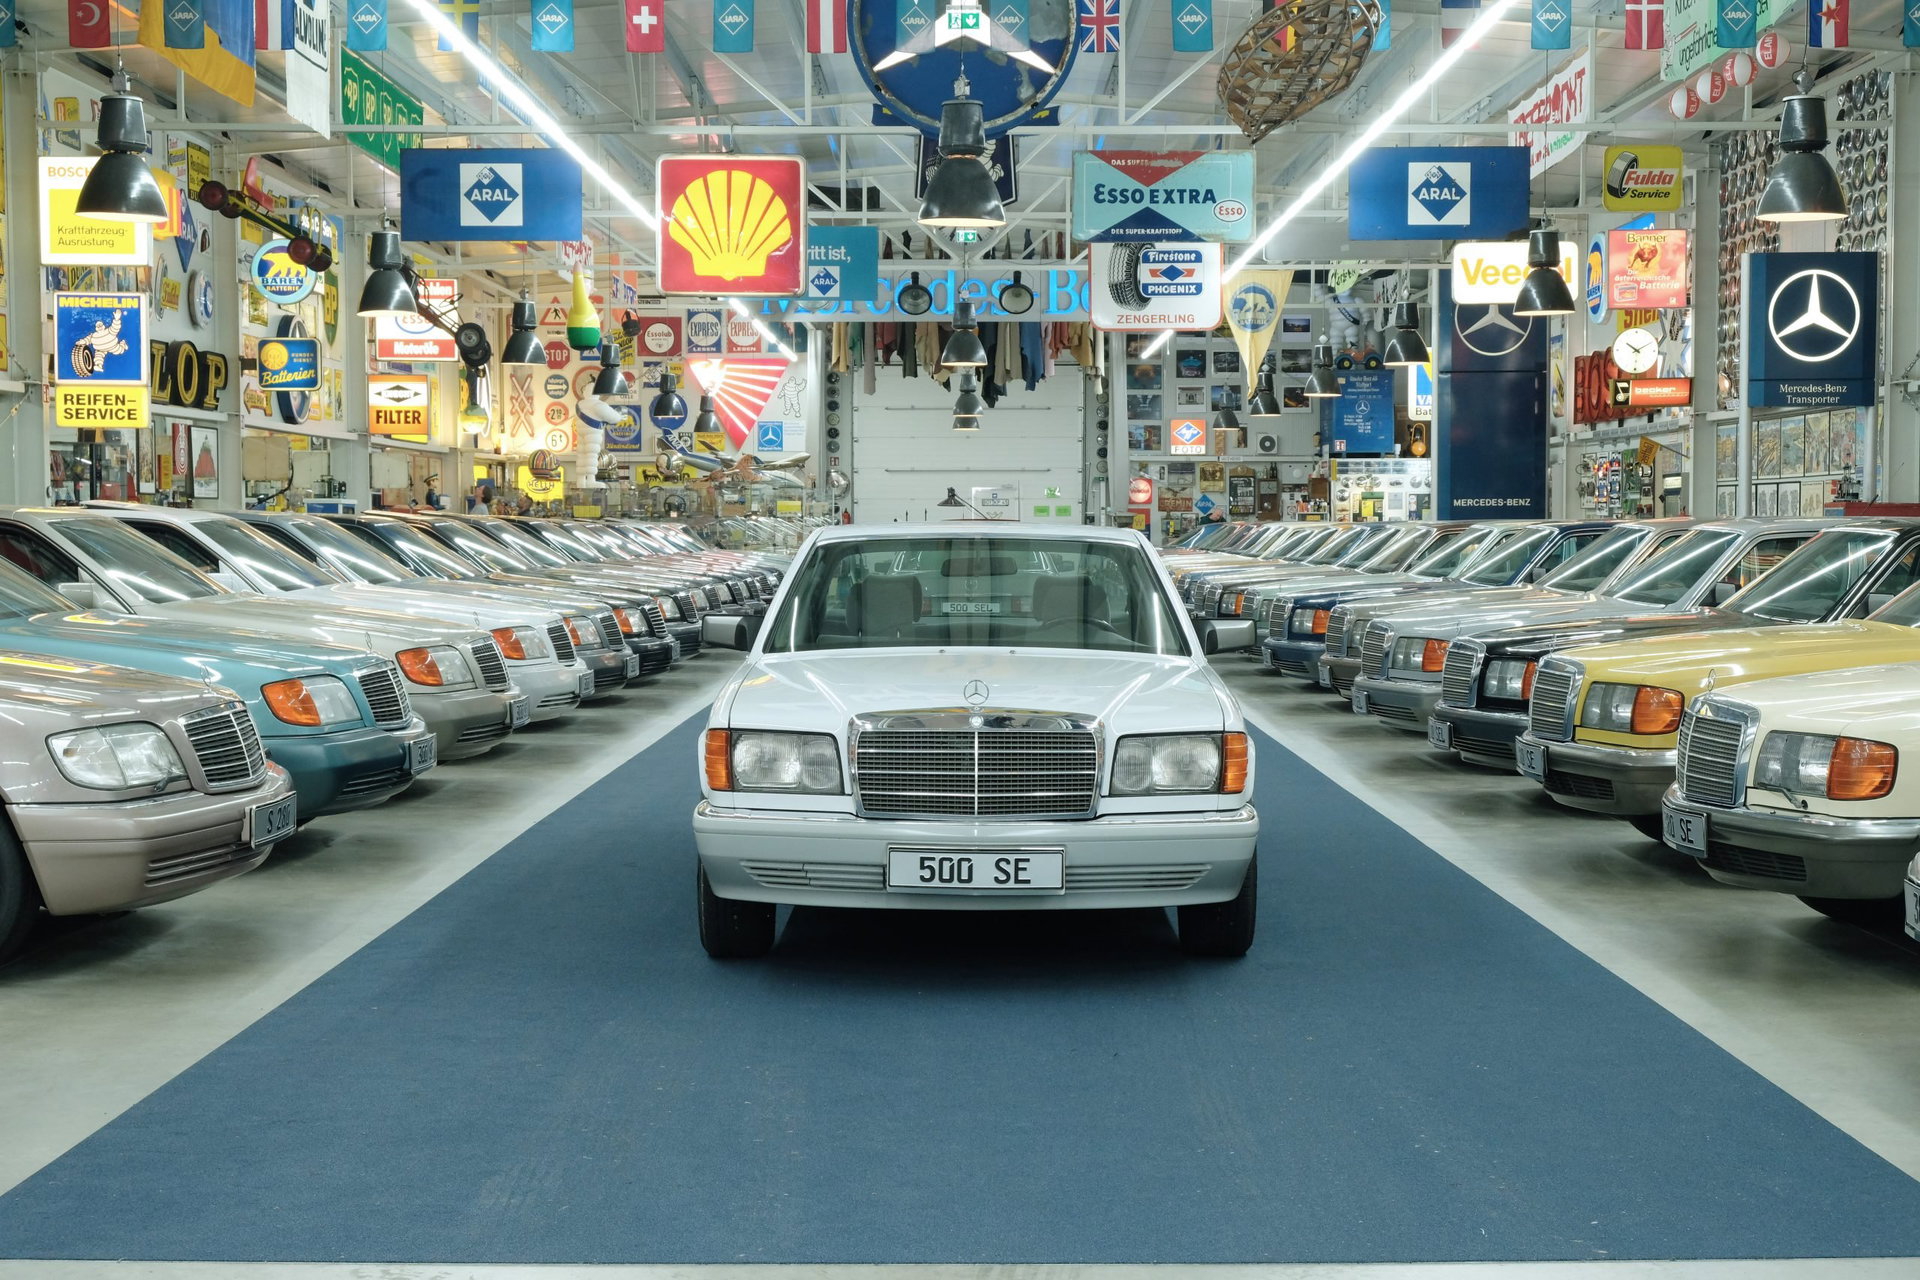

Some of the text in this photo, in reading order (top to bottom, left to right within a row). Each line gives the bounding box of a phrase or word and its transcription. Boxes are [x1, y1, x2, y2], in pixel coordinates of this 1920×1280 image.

[294, 7, 328, 58] ALVOLIN
[1764, 36, 1773, 60] ELAN
[1725, 58, 1734, 81] ELAN
[1713, 75, 1722, 97] ELAN
[1624, 170, 1675, 186] Fulda
[470, 188, 513, 202] ARAL
[1093, 183, 1217, 205] ESSO EXTRA
[1418, 187, 1461, 200] ARAL
[1630, 189, 1671, 199] Service
[1218, 205, 1243, 216] Esso
[57, 225, 128, 236] Kraftfahrzeug-
[181, 224, 195, 243] RAL
[1627, 233, 1667, 243] Banner
[828, 245, 851, 263] ist,
[1148, 251, 1196, 262] Firestone
[1460, 256, 1572, 286] Veel
[813, 278, 836, 286] ARAL
[1640, 282, 1680, 290] Batterie
[1148, 284, 1197, 294] PHOENIX
[59, 297, 139, 308] MICHELIN
[324, 283, 338, 325] BP
[1117, 314, 1195, 323] ZENGERLING
[646, 330, 673, 338] Essolub
[690, 321, 719, 337] EXPRESS
[545, 349, 568, 361] STOP
[261, 367, 316, 386] Batterien
[1634, 386, 1676, 395] becker
[1779, 383, 1848, 394] Mercedes-Benz
[63, 393, 137, 406] REIFEN-
[1786, 394, 1840, 406] Transporter
[63, 407, 138, 420] SERVICE
[375, 409, 422, 425] FILTER
[551, 434, 557, 448] 6
[1453, 498, 1531, 507] MERCEDES-BENZ
[950, 603, 993, 612] 500 SEL
[267, 808, 274, 834] S
[1679, 817, 1694, 844] SE
[919, 856, 1031, 884] 500 SE
